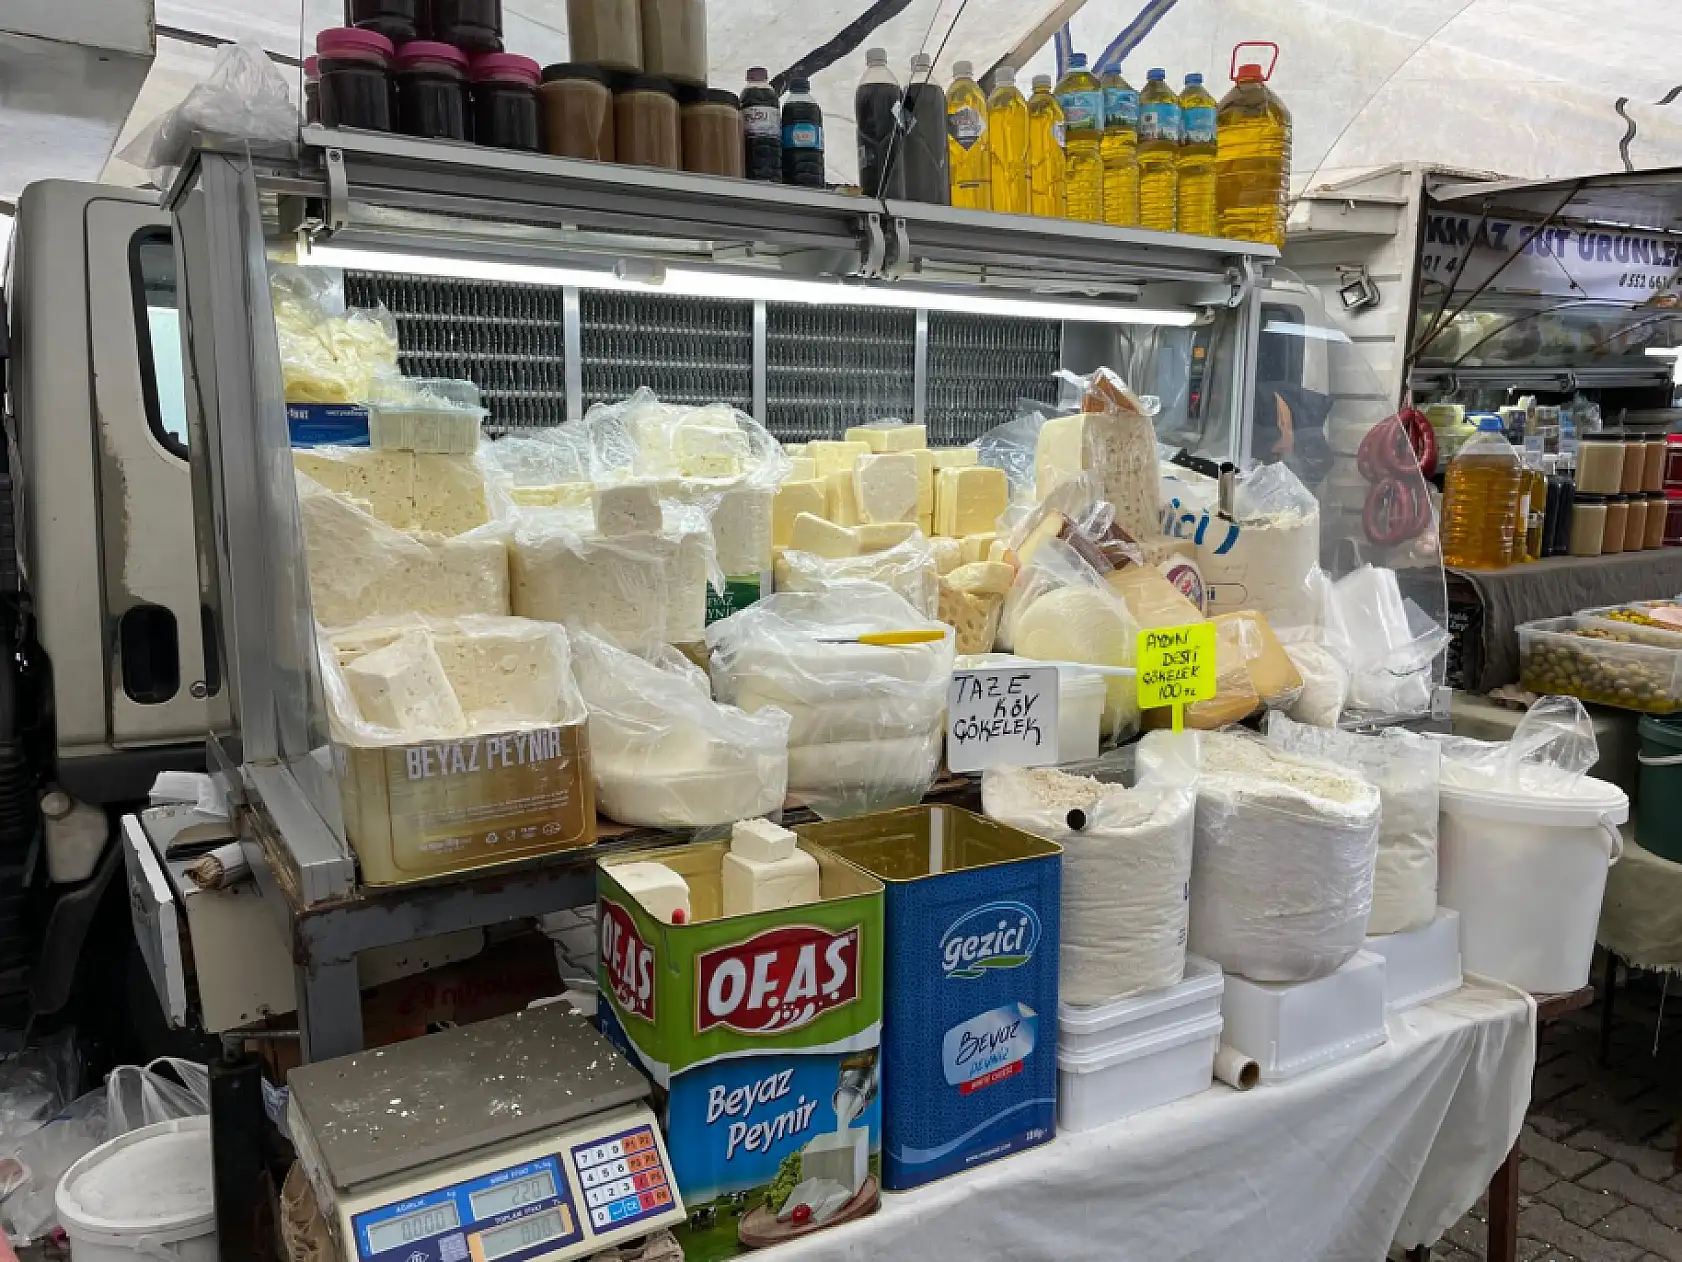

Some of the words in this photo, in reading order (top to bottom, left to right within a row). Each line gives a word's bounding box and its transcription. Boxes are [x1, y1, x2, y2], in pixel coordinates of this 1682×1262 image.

[955, 674, 1031, 704] TAZE
[1158, 682, 1182, 699] 100
[406, 739, 480, 780] BEYAZ
[486, 727, 562, 770] PEYNİR
[953, 714, 1041, 746] ÇÖKELEK
[942, 917, 1028, 971] gezici
[706, 1068, 795, 1125] Beyaz
[725, 1095, 818, 1161] Peynir
